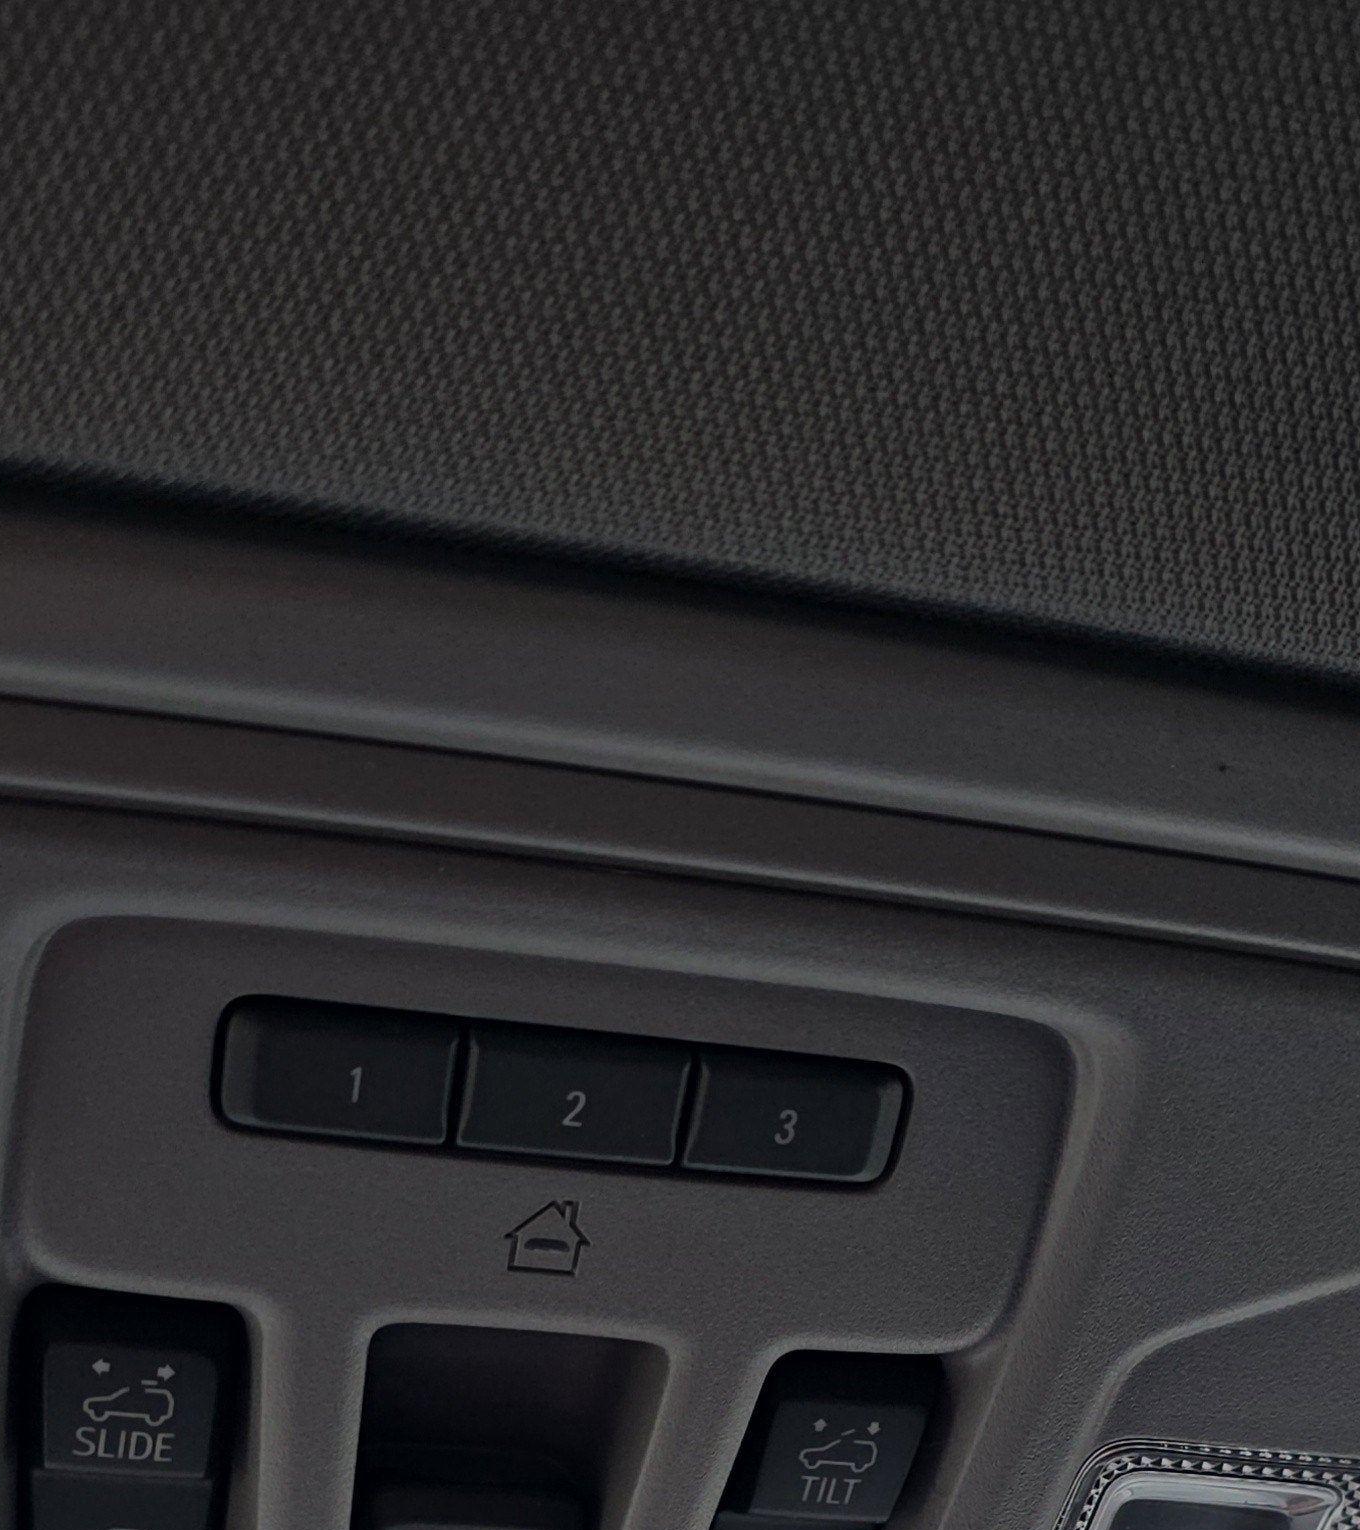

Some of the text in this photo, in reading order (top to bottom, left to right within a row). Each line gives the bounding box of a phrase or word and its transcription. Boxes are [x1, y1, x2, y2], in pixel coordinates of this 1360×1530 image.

[348, 1066, 364, 1104] 1
[561, 1090, 588, 1129] 2
[773, 1108, 799, 1146] 3
[72, 1425, 176, 1463] SLIDE
[800, 1475, 862, 1505] TILT
